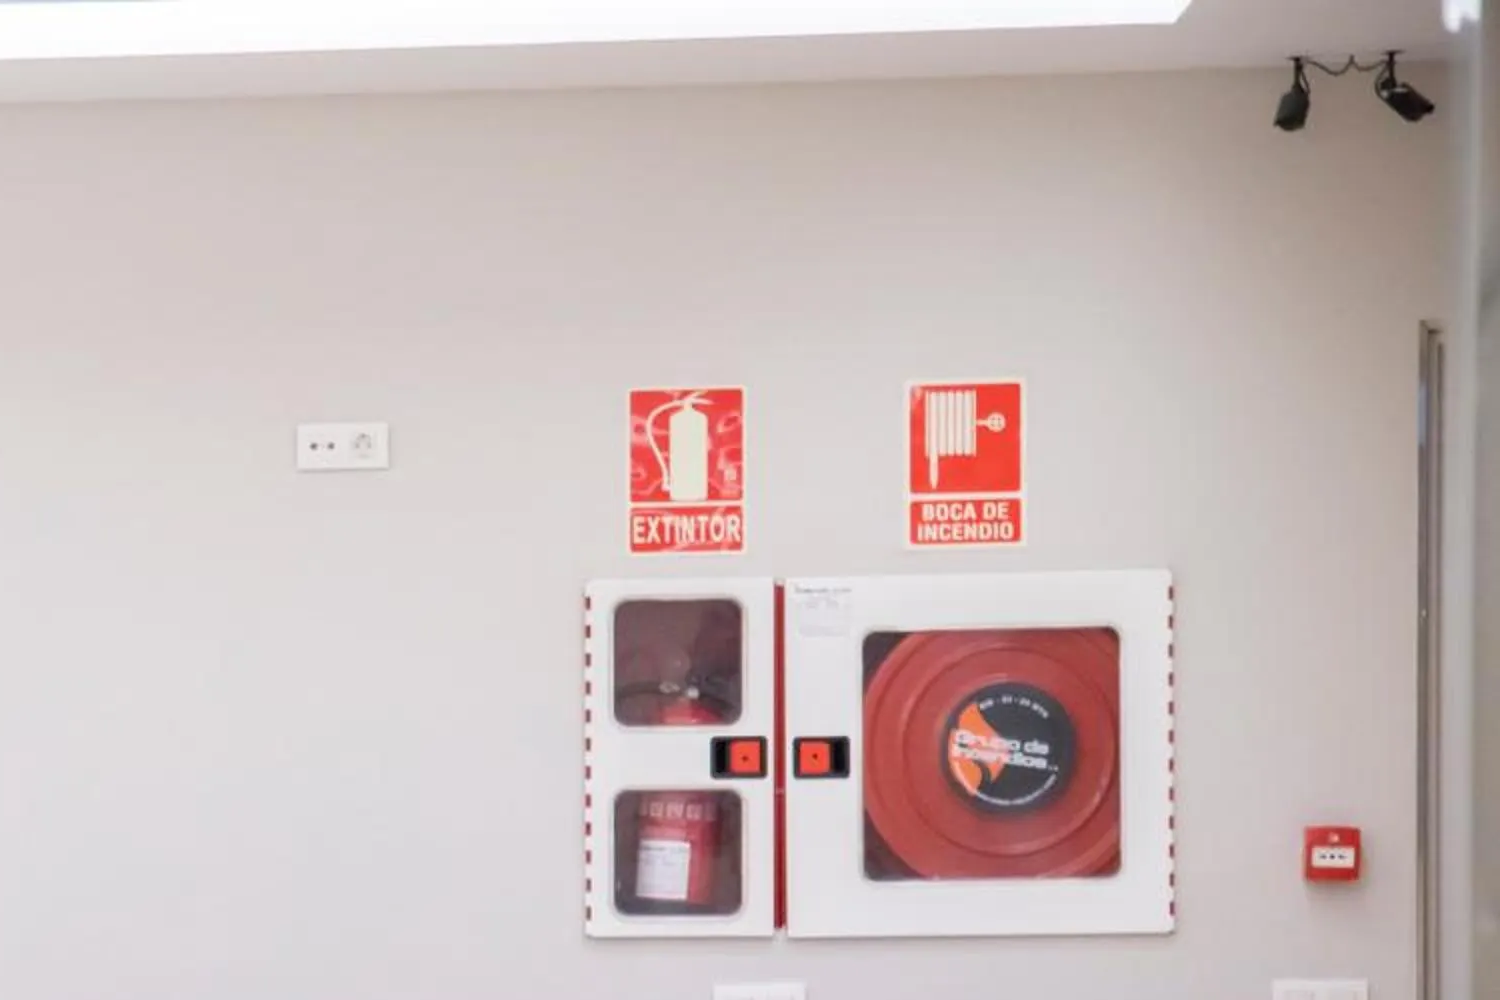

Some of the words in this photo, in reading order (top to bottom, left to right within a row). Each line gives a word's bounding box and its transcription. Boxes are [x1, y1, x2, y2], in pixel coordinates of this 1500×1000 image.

[921, 503, 977, 521] BOCA
[982, 502, 1011, 520] DE
[632, 514, 741, 545] EXTINTOR
[917, 521, 1014, 541] INCENDIO
